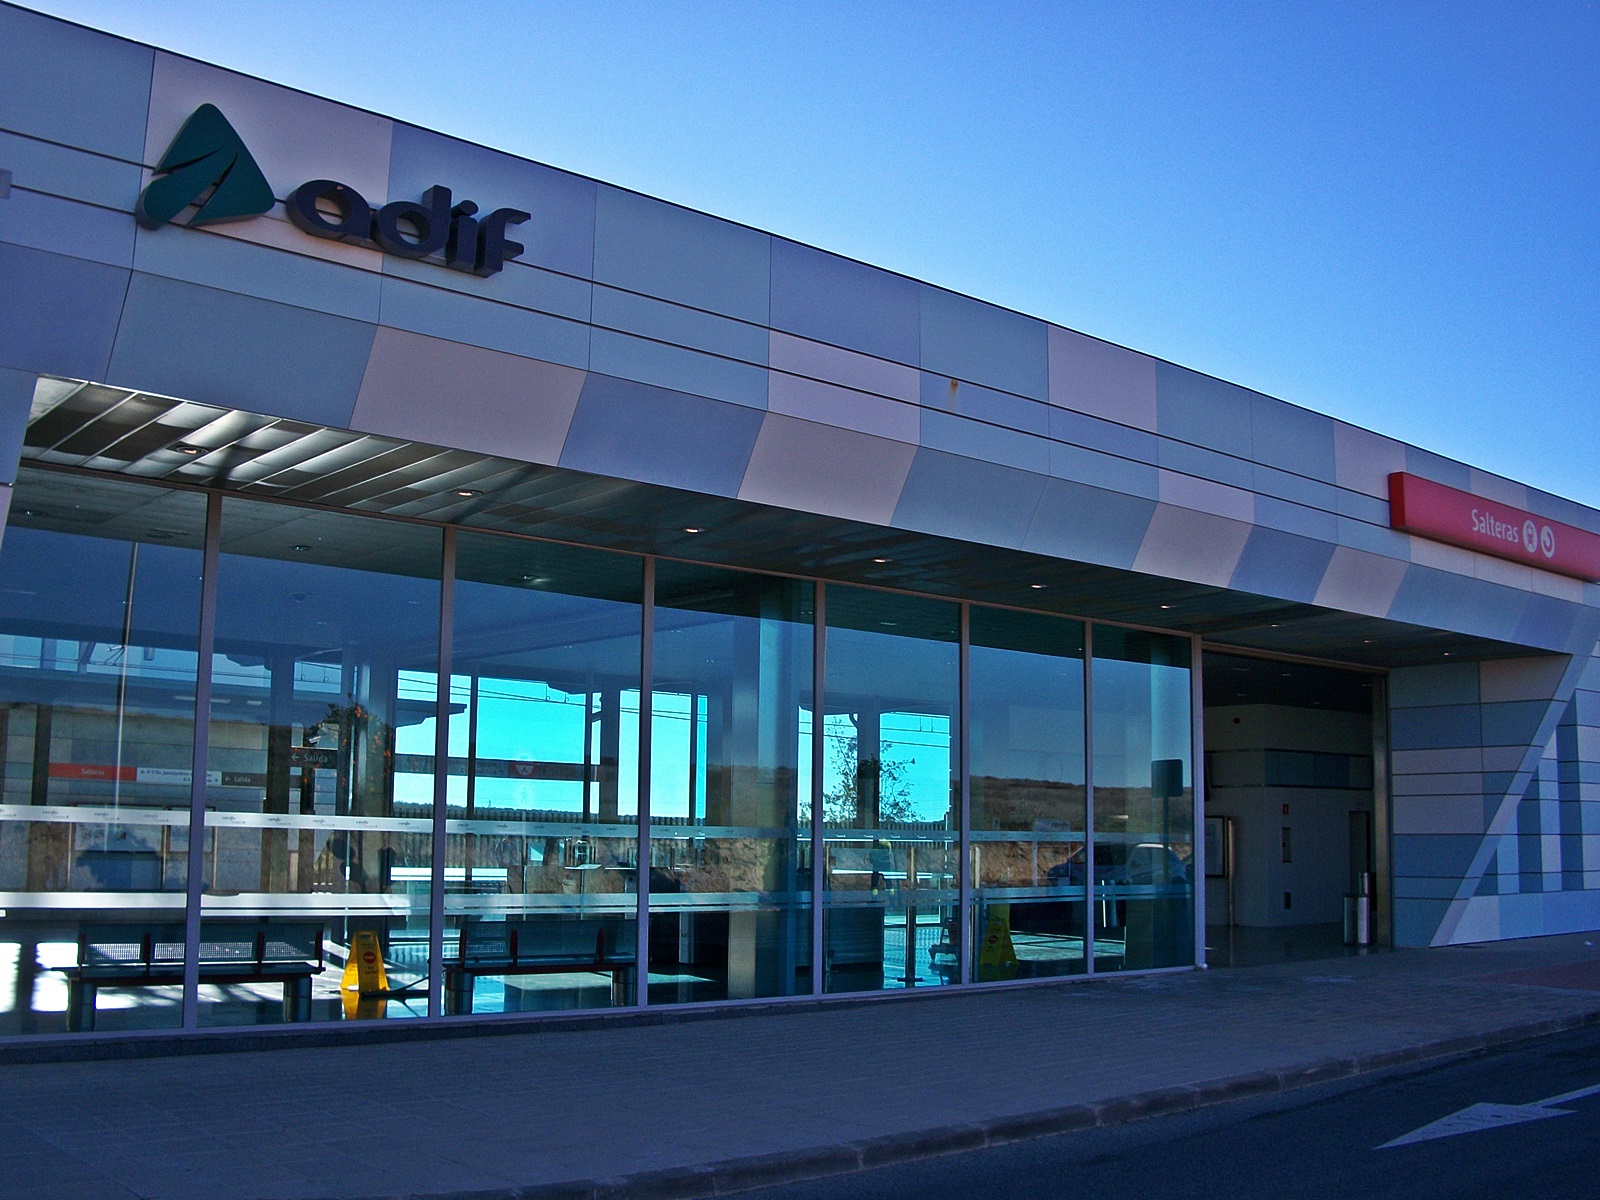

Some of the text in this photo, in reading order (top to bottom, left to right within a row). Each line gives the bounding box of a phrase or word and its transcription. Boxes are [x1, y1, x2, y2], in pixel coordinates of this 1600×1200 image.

[286, 179, 531, 278] adif
[1471, 508, 1519, 543] Salteras
[304, 754, 328, 763] Salida
